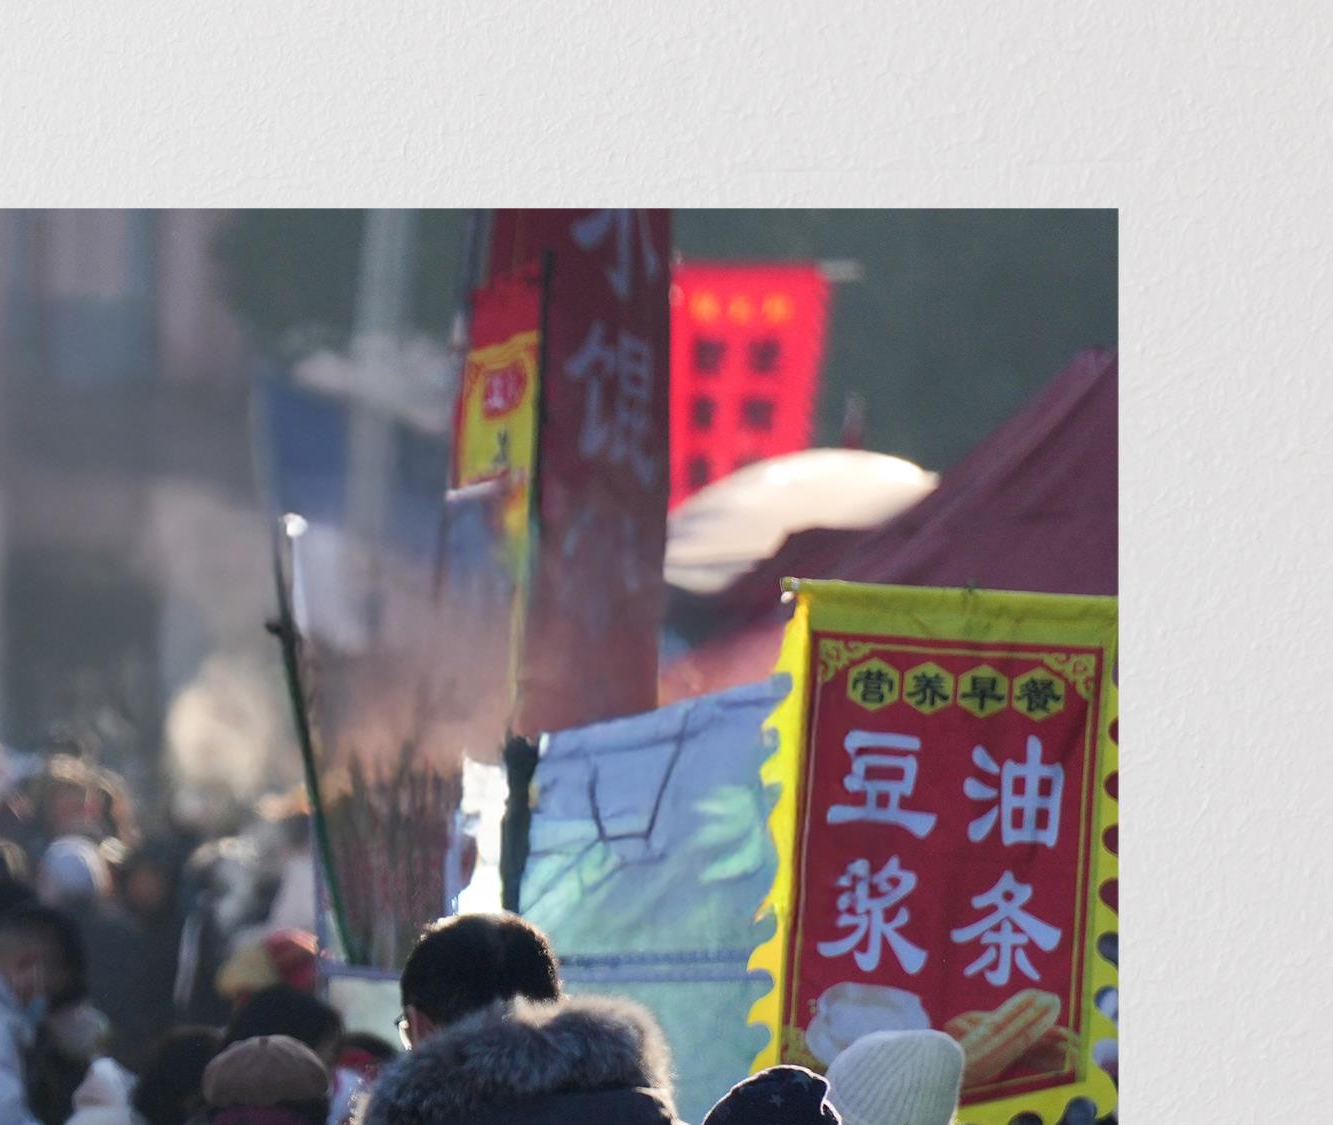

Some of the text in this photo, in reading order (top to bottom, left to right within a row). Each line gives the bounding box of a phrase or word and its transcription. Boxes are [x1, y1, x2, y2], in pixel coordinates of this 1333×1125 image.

[852, 668, 1064, 714] 营养早餐
[817, 729, 938, 976] 豆浆
[951, 735, 1064, 986] 油条
